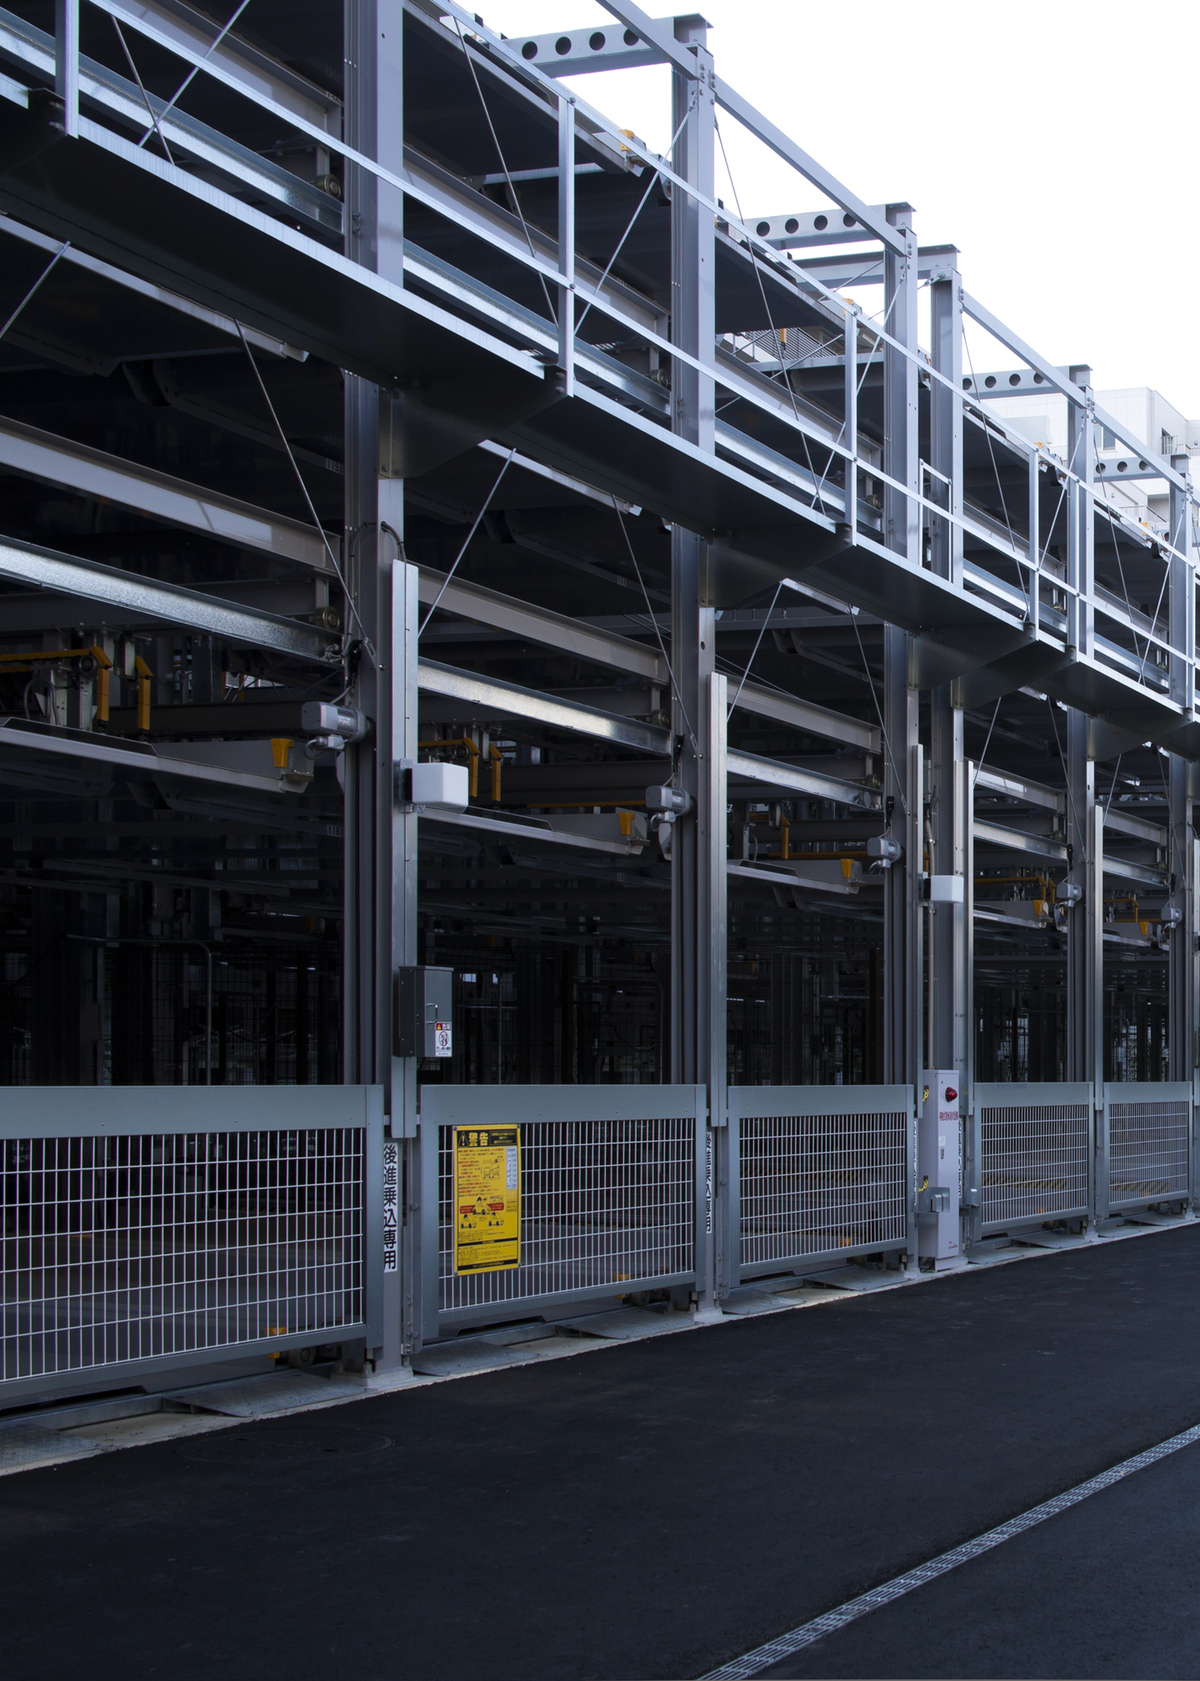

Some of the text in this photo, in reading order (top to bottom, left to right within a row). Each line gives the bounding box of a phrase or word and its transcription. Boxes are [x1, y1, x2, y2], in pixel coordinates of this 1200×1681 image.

[327, 459, 339, 472] 119
[328, 825, 340, 836] 118
[383, 1144, 398, 1270] 後進乗込専用
